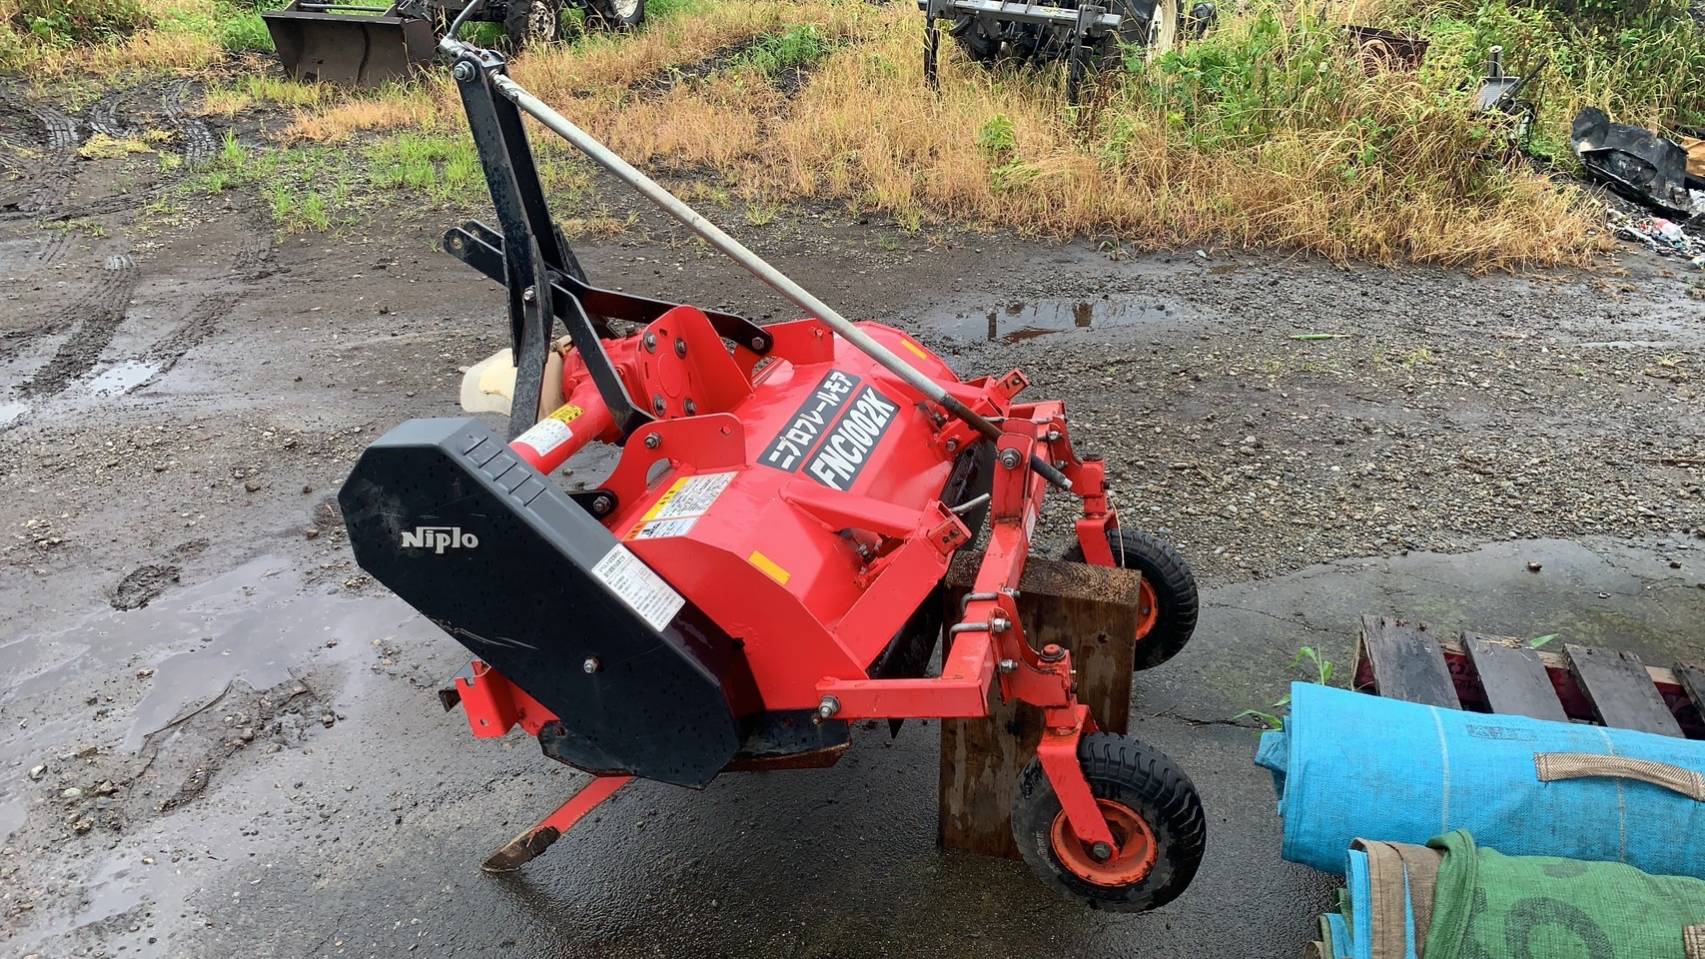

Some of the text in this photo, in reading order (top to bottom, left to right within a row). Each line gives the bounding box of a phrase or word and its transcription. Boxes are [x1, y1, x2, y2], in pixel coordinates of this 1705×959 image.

[768, 371, 853, 470] ニプロフレールモア
[809, 387, 895, 491] FNC1002K
[401, 526, 479, 554] Niplo
